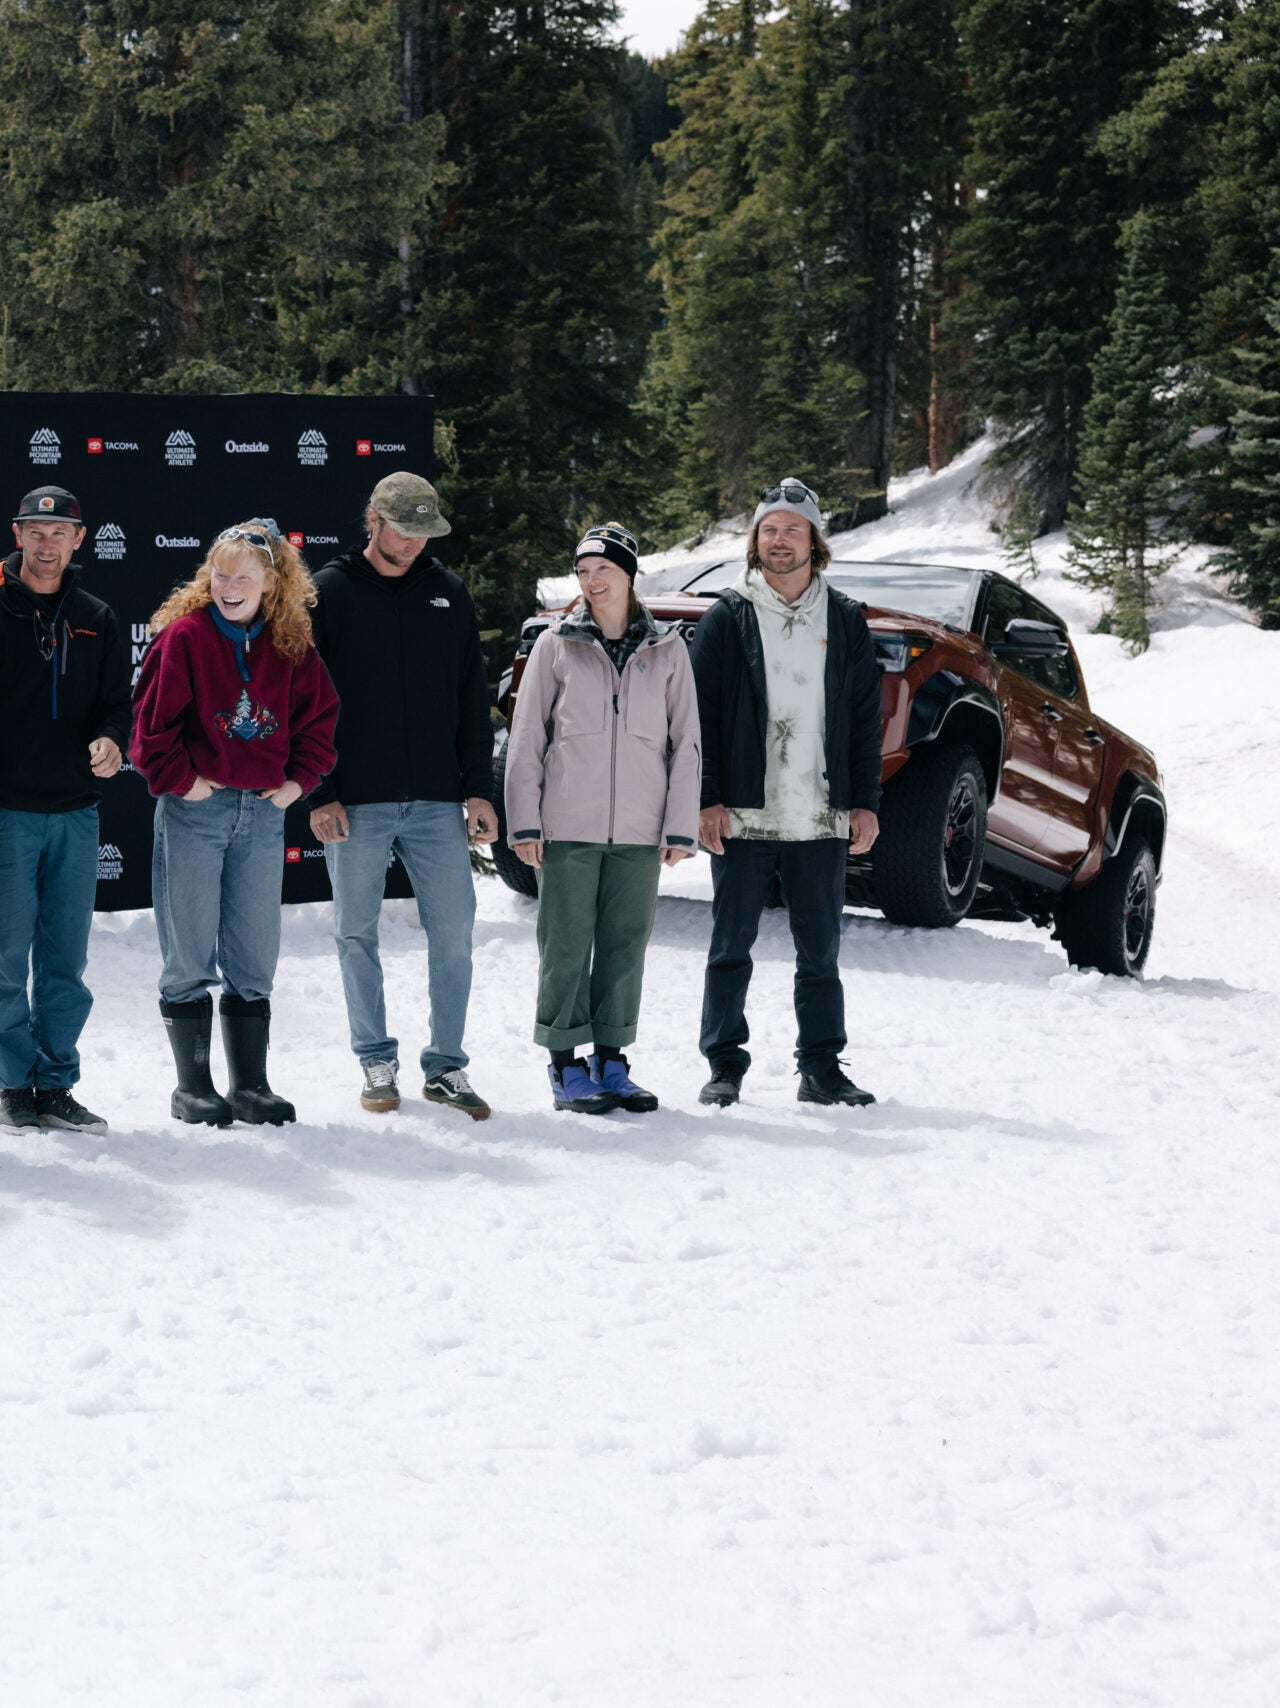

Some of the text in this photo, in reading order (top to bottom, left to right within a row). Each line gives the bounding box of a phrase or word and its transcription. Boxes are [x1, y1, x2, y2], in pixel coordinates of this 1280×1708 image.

[104, 441, 139, 451] TACOMA
[224, 439, 270, 454] Outside
[372, 443, 407, 452] TACOMA
[154, 534, 201, 548] Outside
[305, 535, 340, 544] TACOMA
[302, 849, 327, 858] TACO
